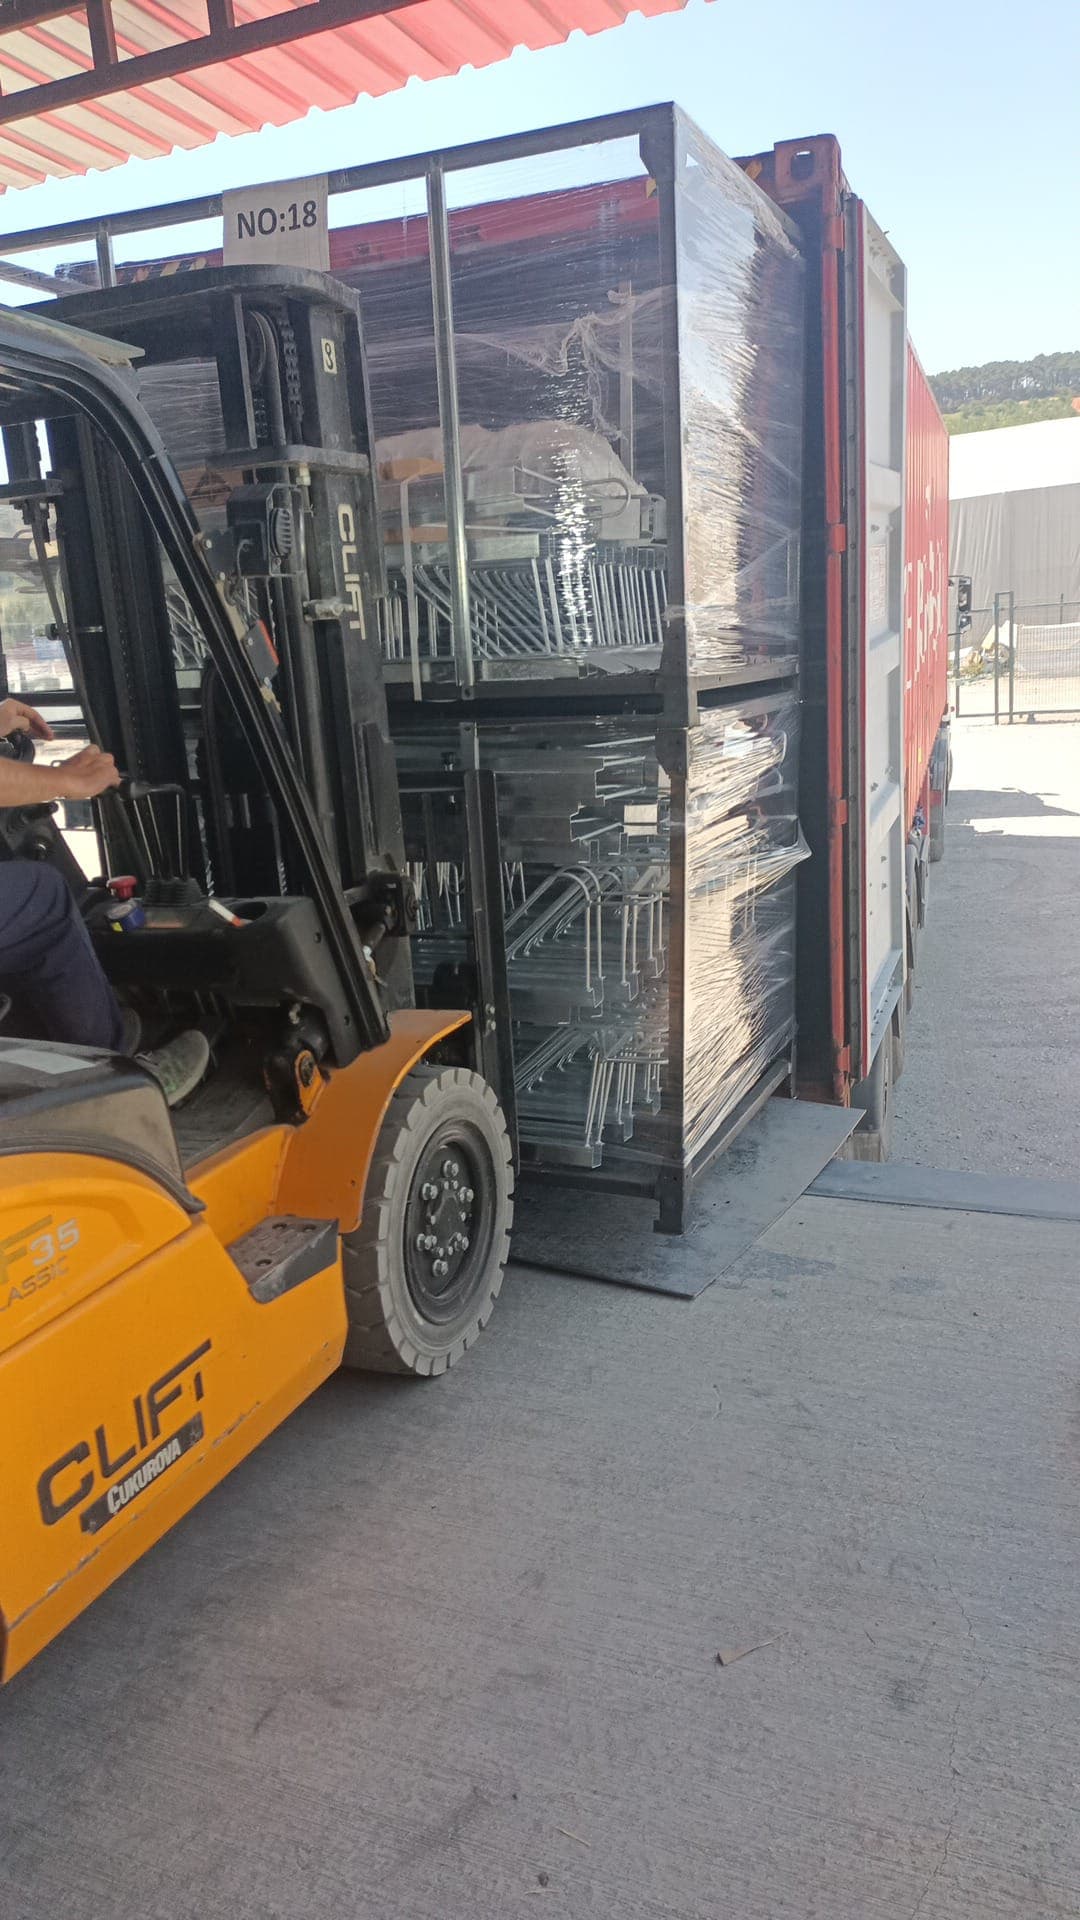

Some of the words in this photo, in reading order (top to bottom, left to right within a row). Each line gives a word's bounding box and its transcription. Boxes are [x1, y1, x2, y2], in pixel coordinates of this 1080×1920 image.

[237, 200, 317, 239] NO:18
[337, 503, 367, 641] CLIFT
[36, 1338, 212, 1527] CLIFT
[107, 1438, 182, 1515] ÇUKUROVA
